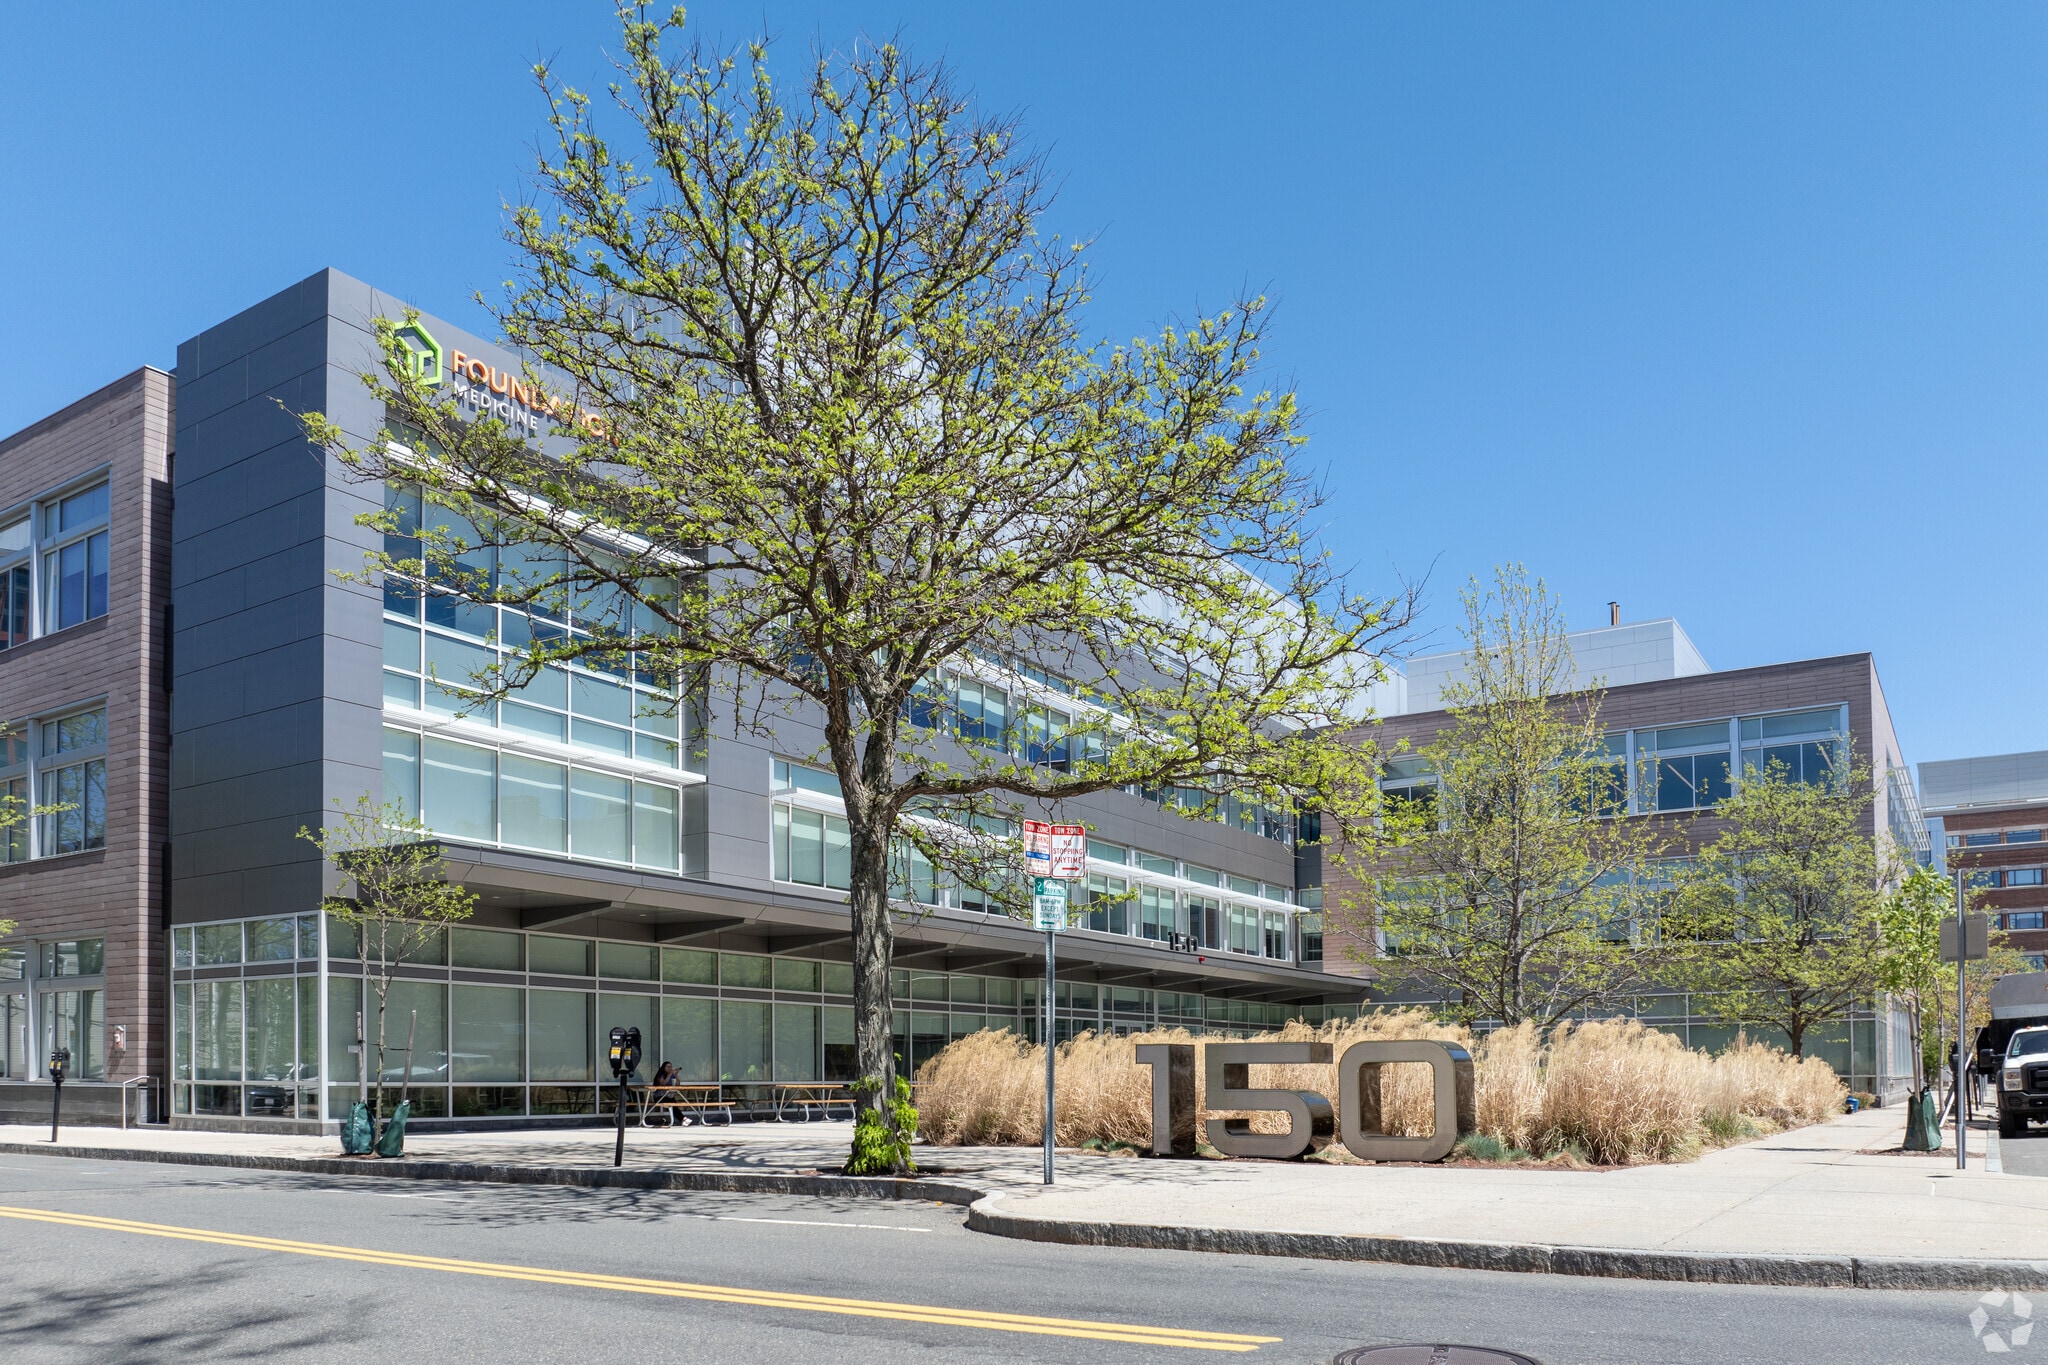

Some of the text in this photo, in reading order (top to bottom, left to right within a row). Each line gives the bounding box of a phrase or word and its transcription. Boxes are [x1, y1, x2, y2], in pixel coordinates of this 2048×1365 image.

[453, 381, 538, 430] MEDICINE
[1025, 823, 1049, 834] TOW ZONE
[1054, 827, 1080, 835] TOW ZONE
[1037, 881, 1042, 892] 2
[1135, 1040, 1475, 1162] 150
